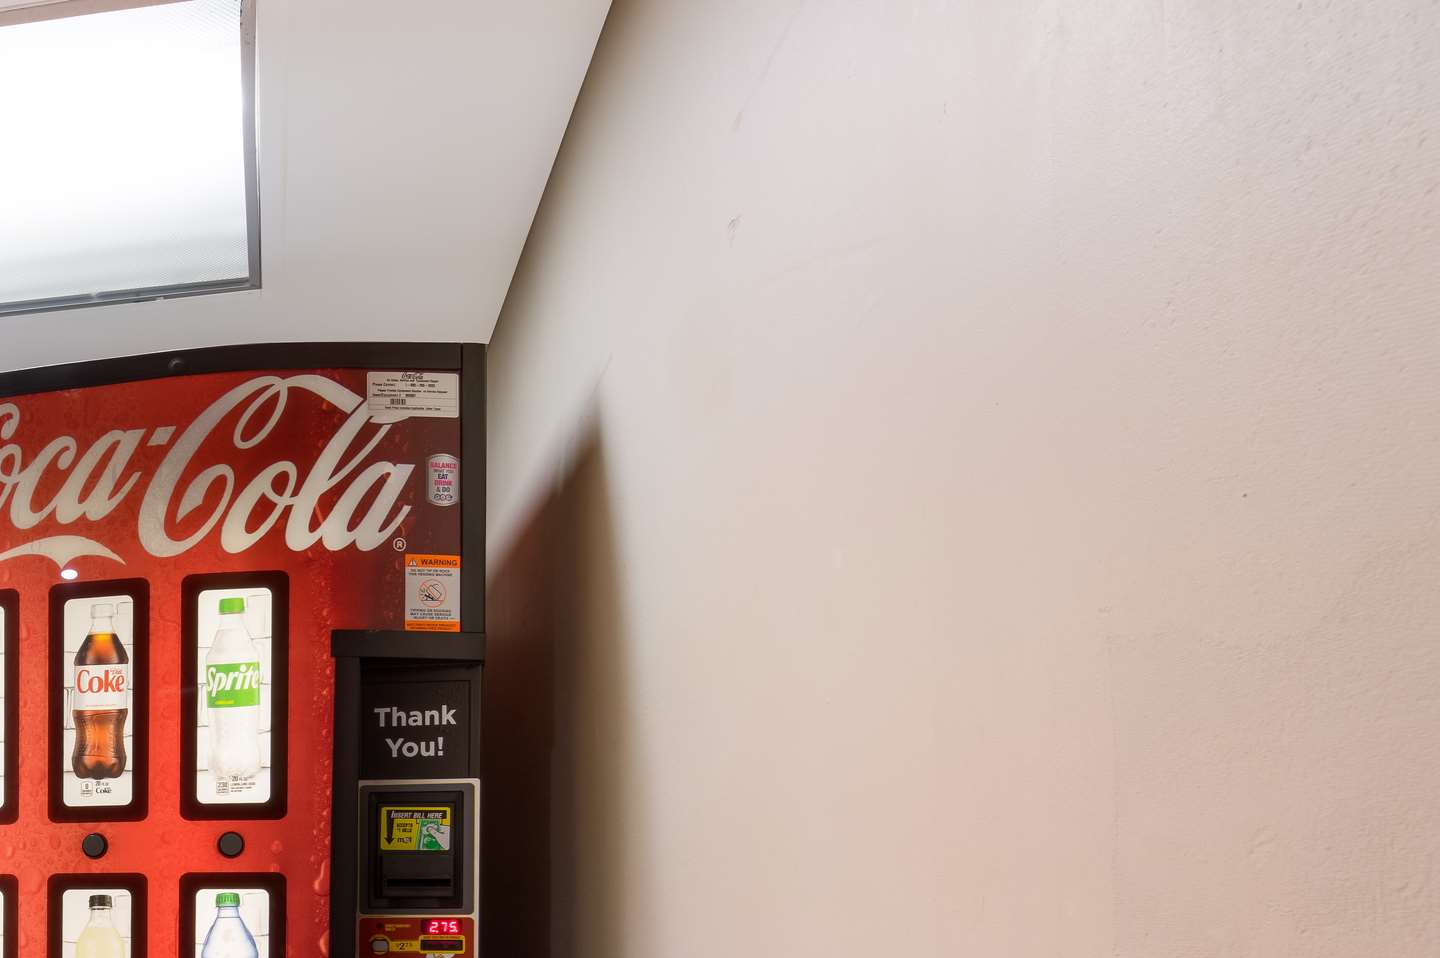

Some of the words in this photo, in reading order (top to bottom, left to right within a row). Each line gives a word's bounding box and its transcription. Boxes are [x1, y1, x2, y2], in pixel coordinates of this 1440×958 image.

[77, 669, 124, 693] Coke
[207, 664, 261, 697] Sprite
[374, 705, 457, 727] Thank
[385, 737, 444, 757] You!
[391, 811, 411, 819] INSERT
